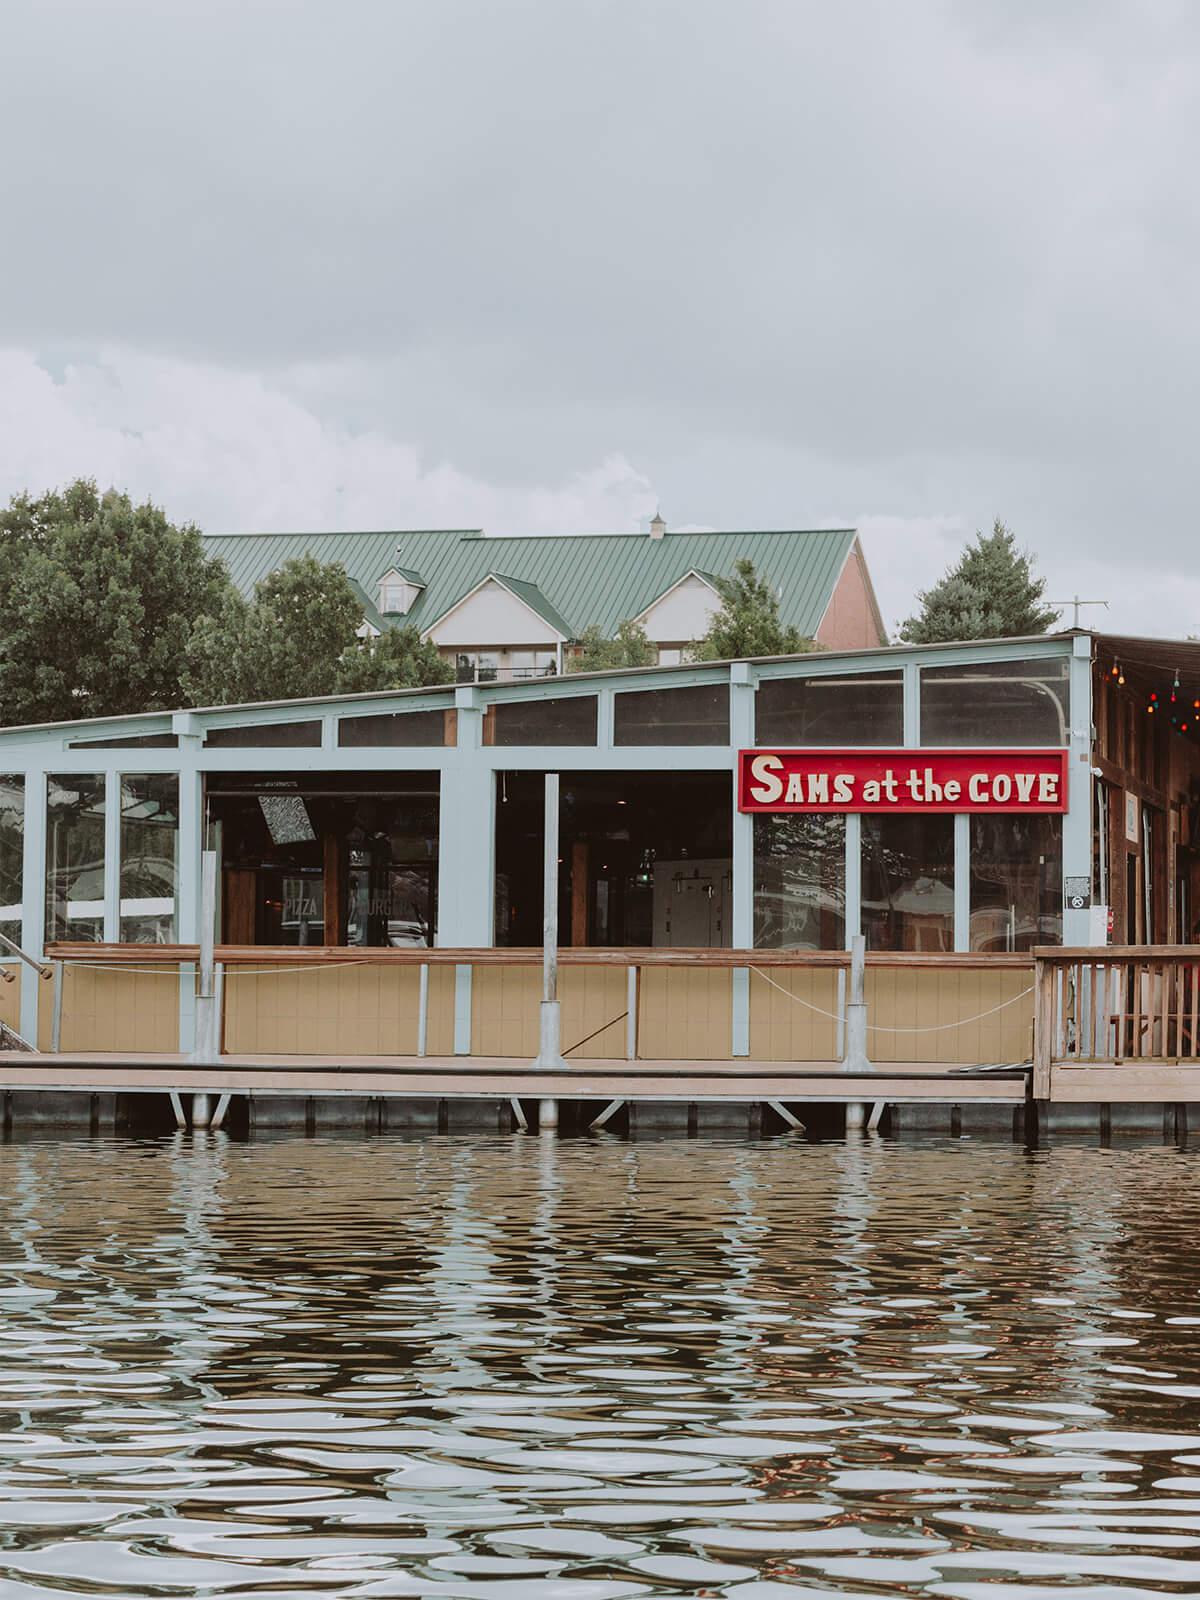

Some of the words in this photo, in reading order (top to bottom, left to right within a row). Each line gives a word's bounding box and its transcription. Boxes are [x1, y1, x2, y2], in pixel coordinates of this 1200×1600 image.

[862, 769, 898, 802] at
[905, 768, 961, 802] the
[967, 773, 1059, 803] COVE
[284, 898, 318, 916] PIZZA
[357, 898, 414, 916] BURGE
